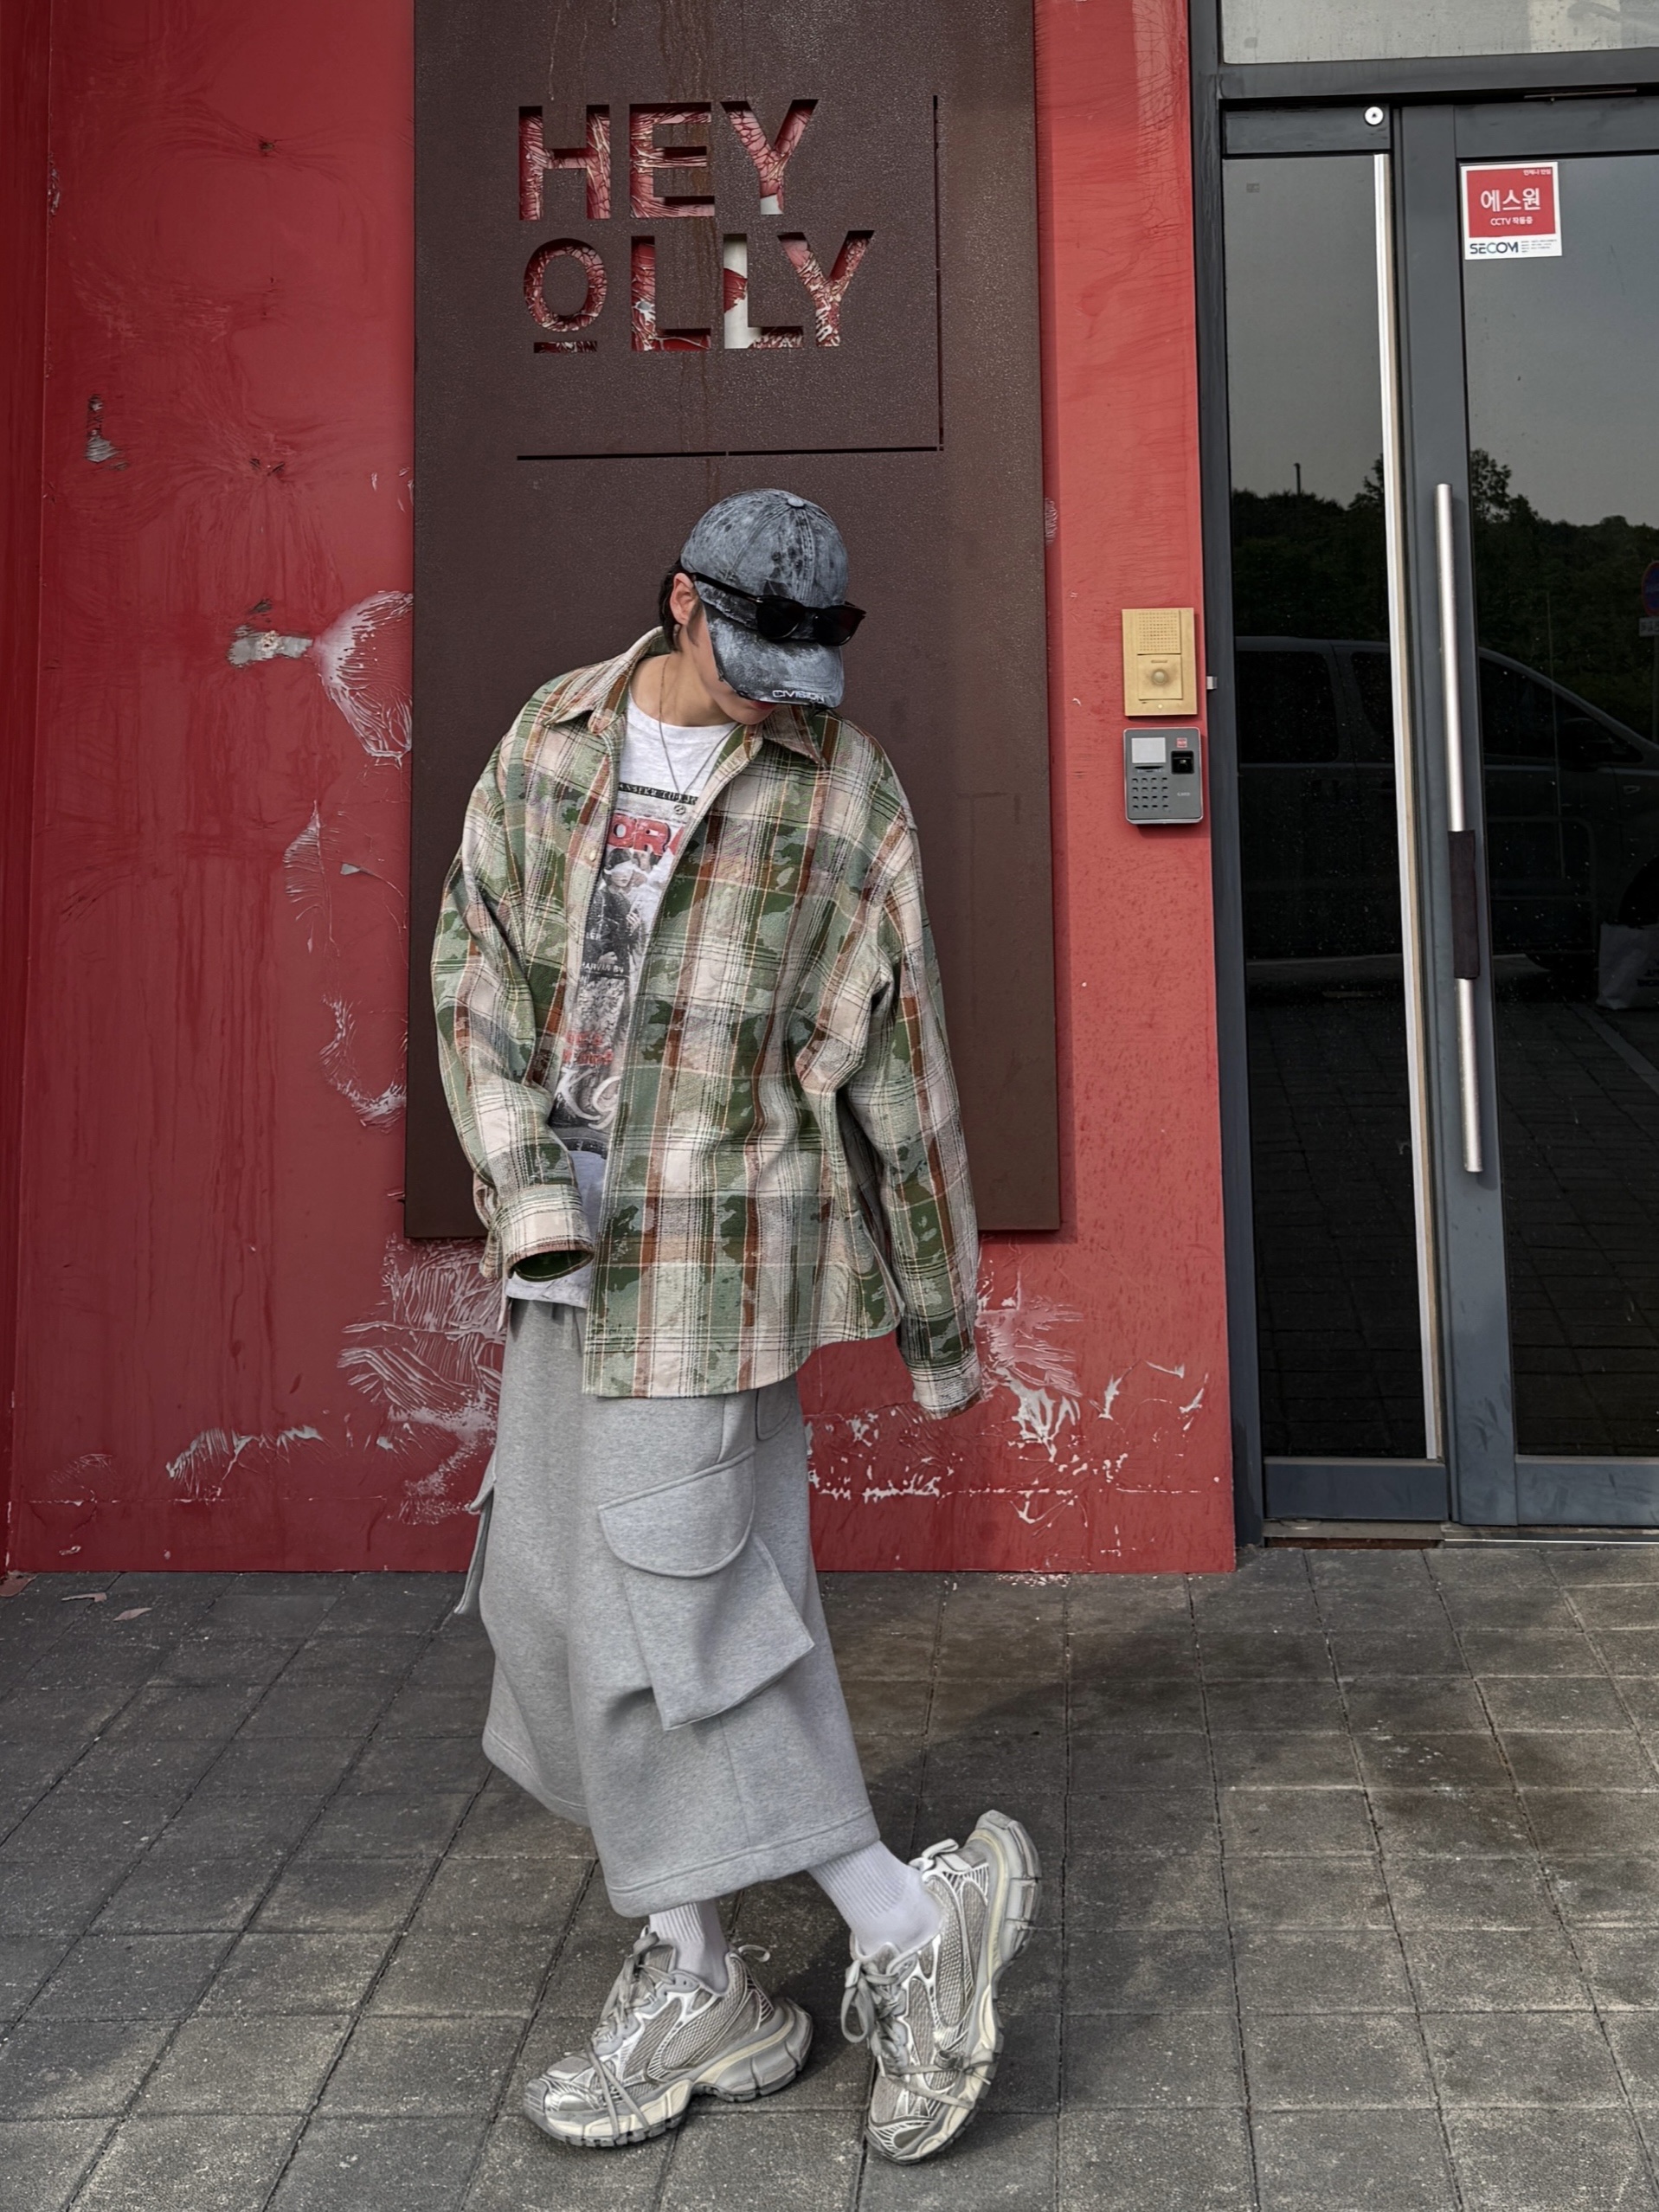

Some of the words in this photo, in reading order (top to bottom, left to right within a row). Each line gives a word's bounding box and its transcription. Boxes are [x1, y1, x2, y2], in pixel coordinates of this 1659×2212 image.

[519, 100, 820, 220] HEY
[1480, 188, 1540, 212] 에스원
[1490, 217, 1511, 226] CCTV
[1469, 241, 1519, 254] SECOM
[524, 230, 875, 351] OLLY
